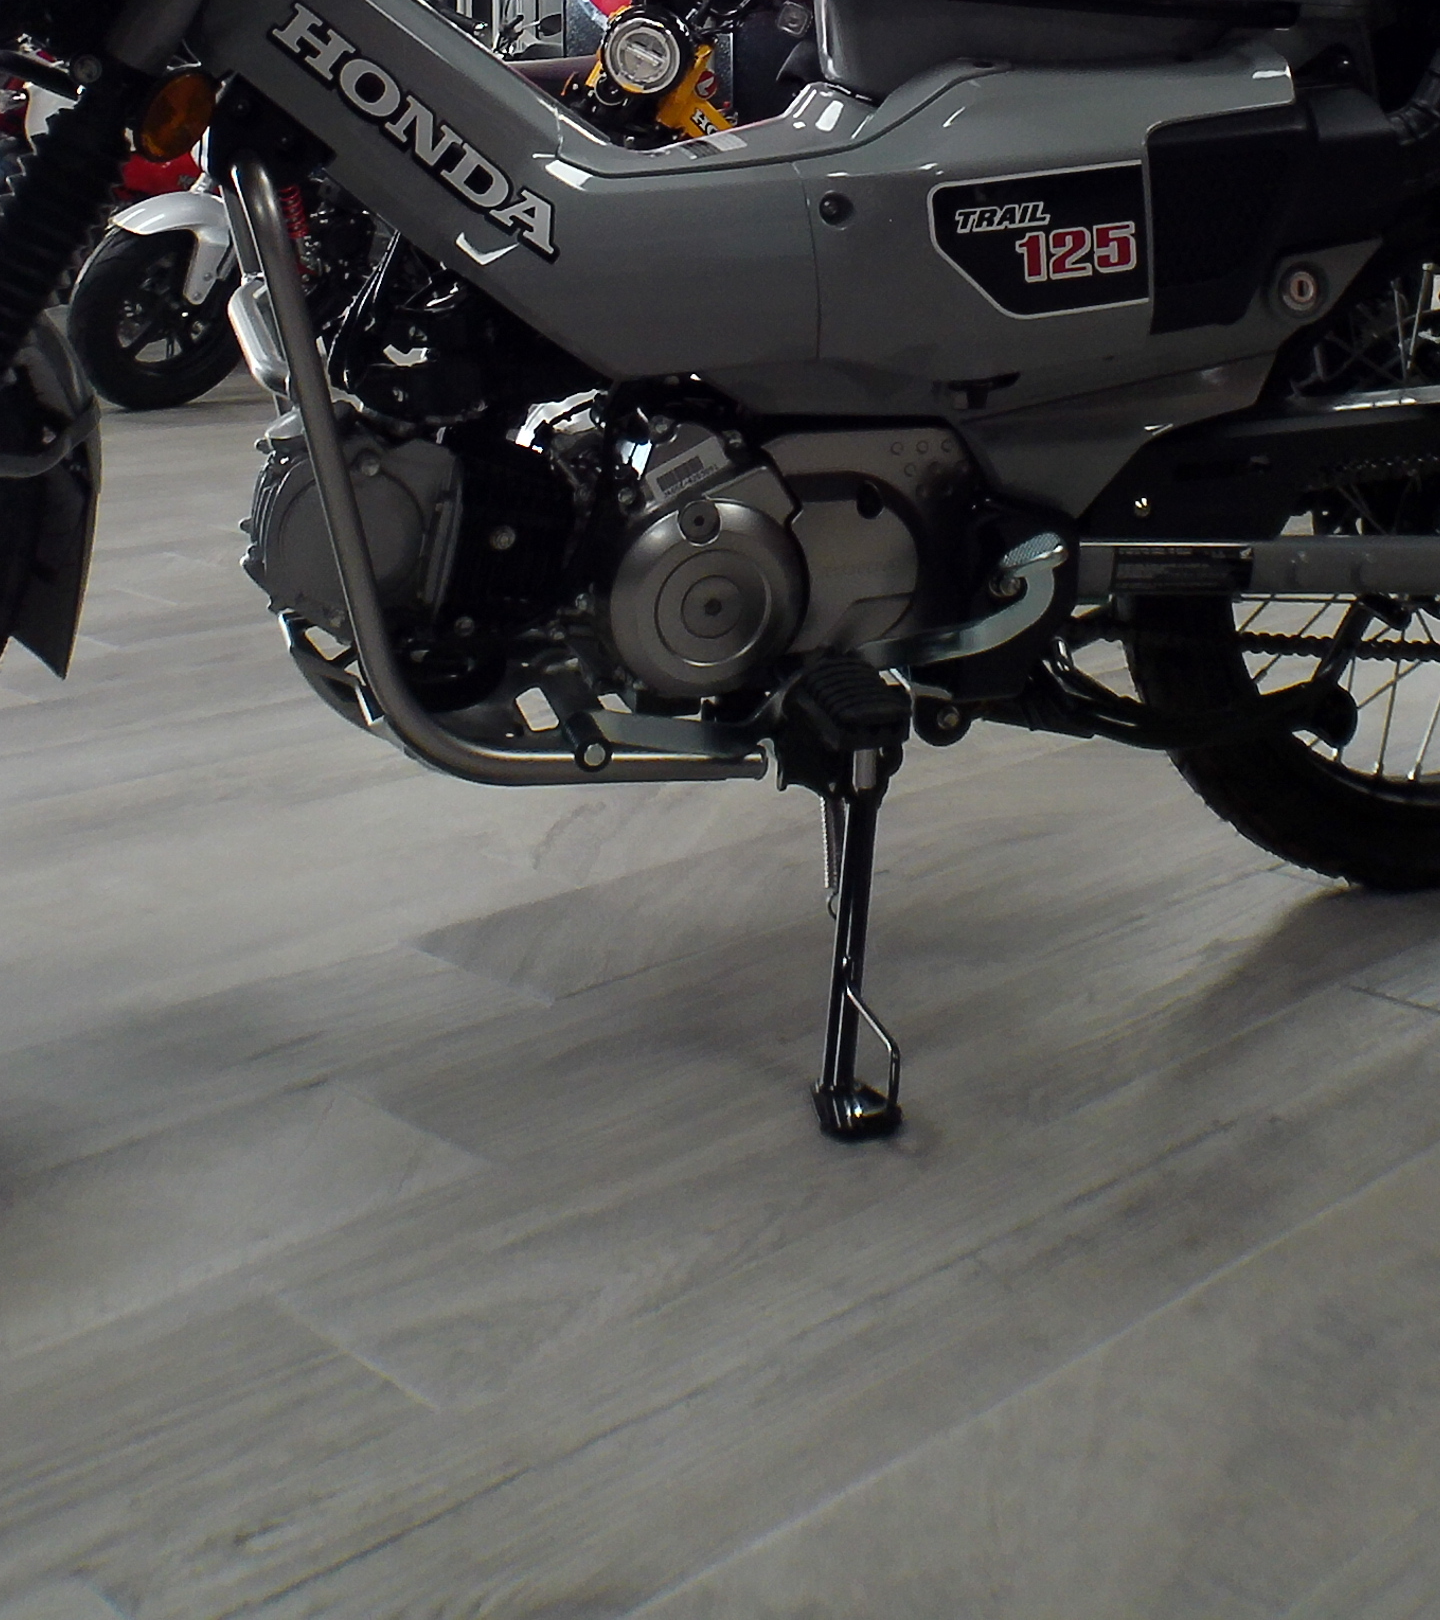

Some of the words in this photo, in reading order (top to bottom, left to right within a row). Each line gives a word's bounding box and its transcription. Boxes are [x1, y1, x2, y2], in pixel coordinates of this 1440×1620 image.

[272, 2, 555, 255] HONDA
[955, 201, 1051, 233] TRAIL
[1015, 221, 1137, 283] 125
